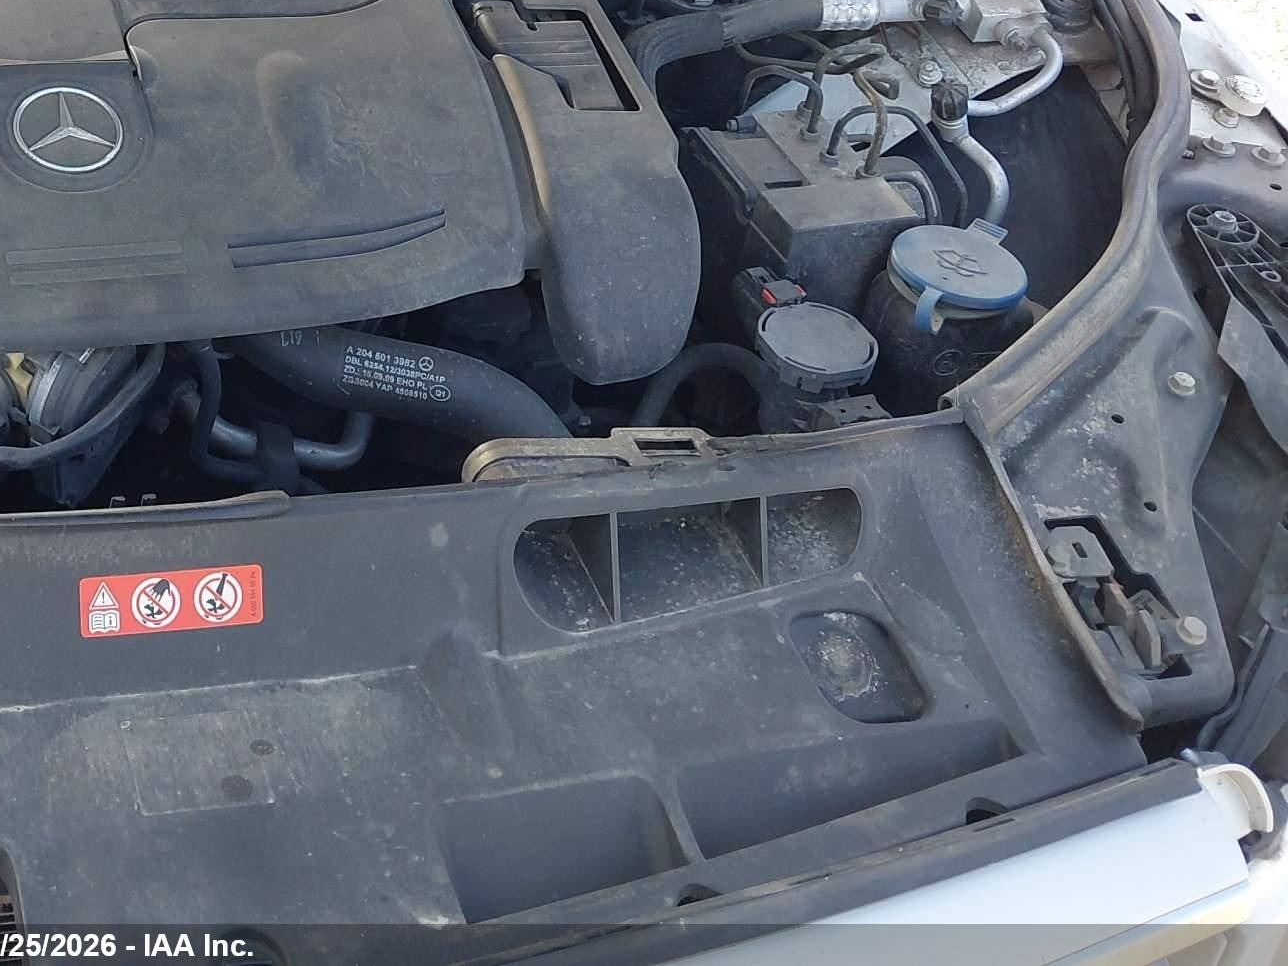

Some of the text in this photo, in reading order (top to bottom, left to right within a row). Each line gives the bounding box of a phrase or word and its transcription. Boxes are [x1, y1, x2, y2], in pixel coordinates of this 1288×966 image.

[346, 345, 354, 354] A
[356, 347, 372, 359] 204
[345, 355, 362, 367] DBL
